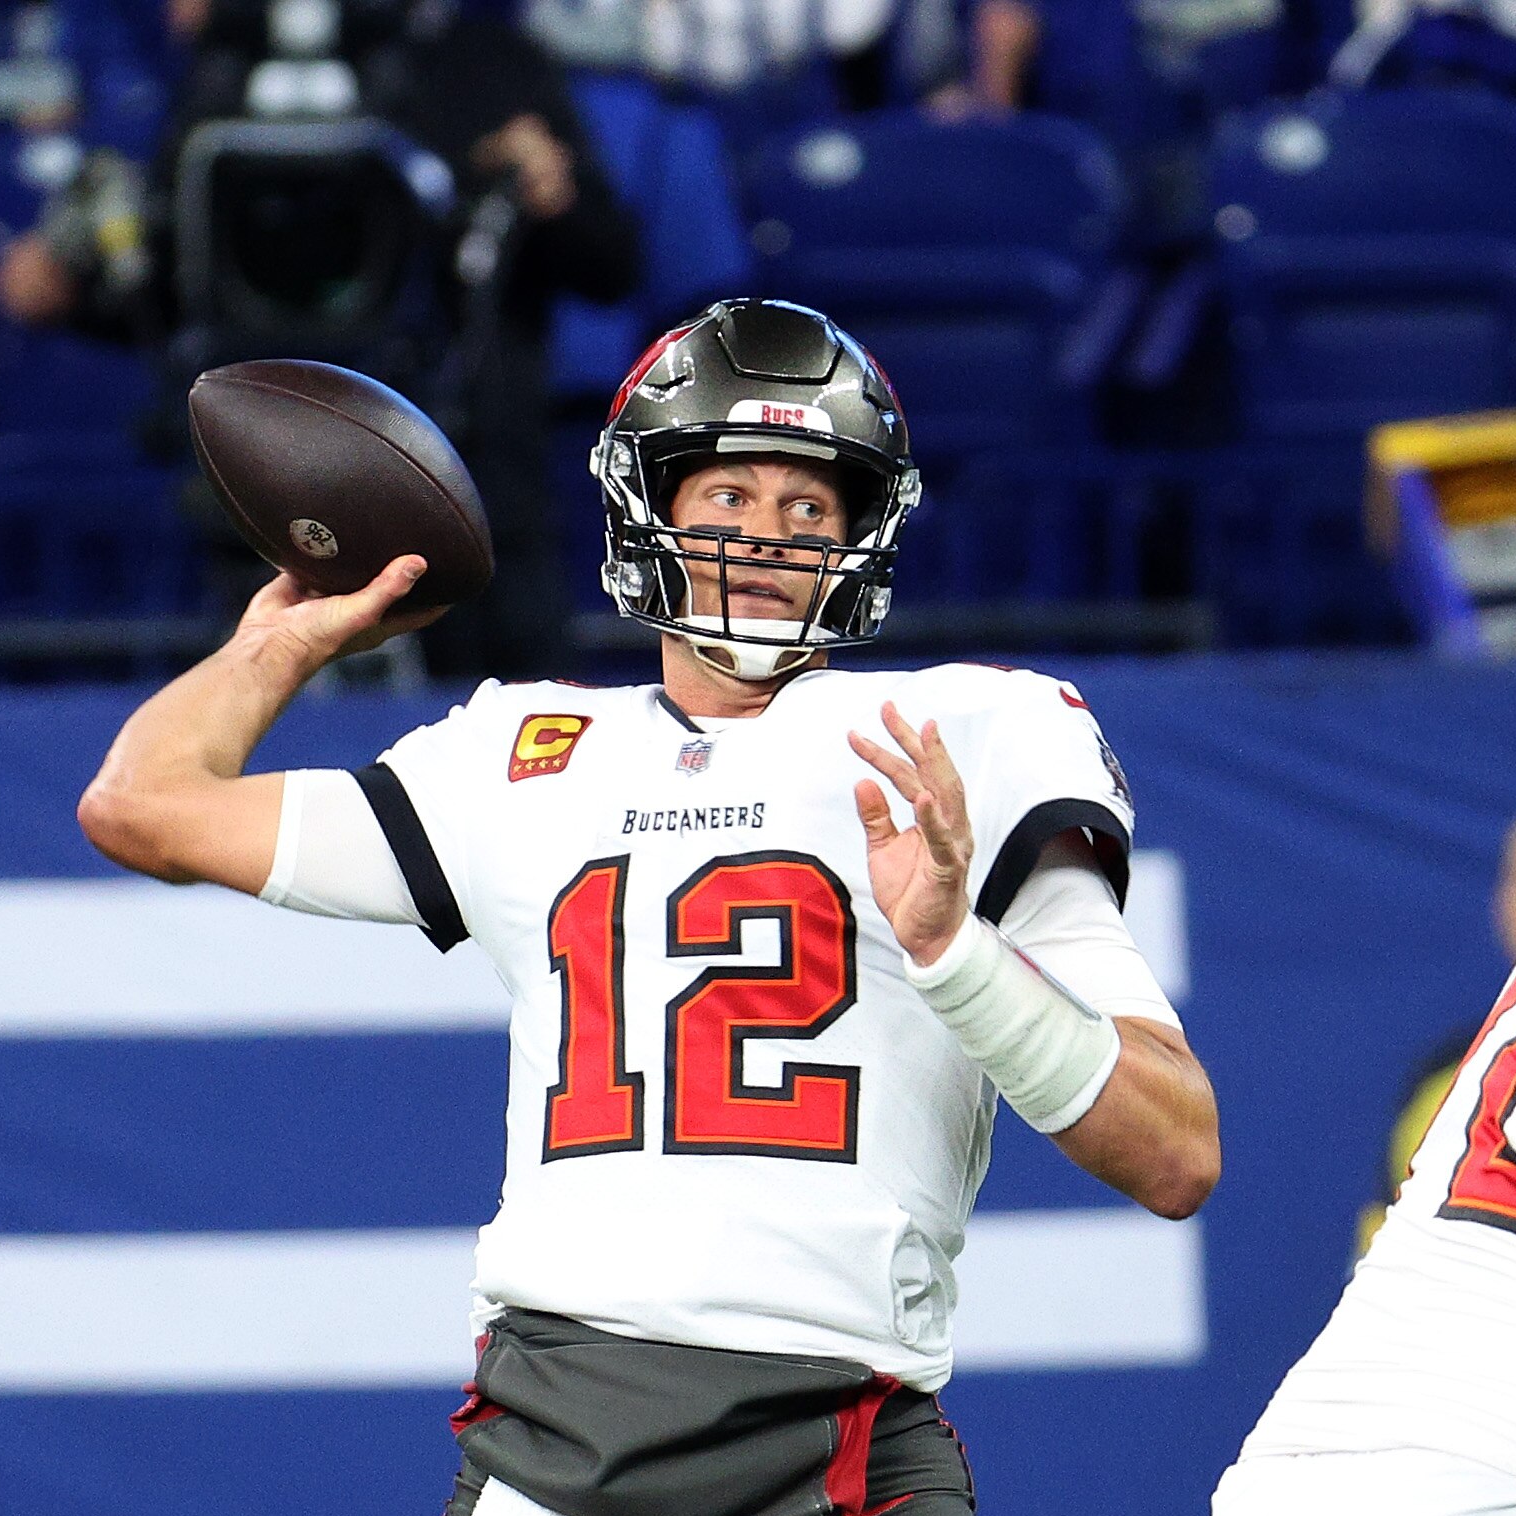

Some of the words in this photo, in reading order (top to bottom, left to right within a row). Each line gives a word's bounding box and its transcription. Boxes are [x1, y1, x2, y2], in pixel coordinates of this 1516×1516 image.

[516, 717, 582, 760] C
[621, 801, 765, 838] BUCCANEERS
[541, 849, 861, 1166] 12
